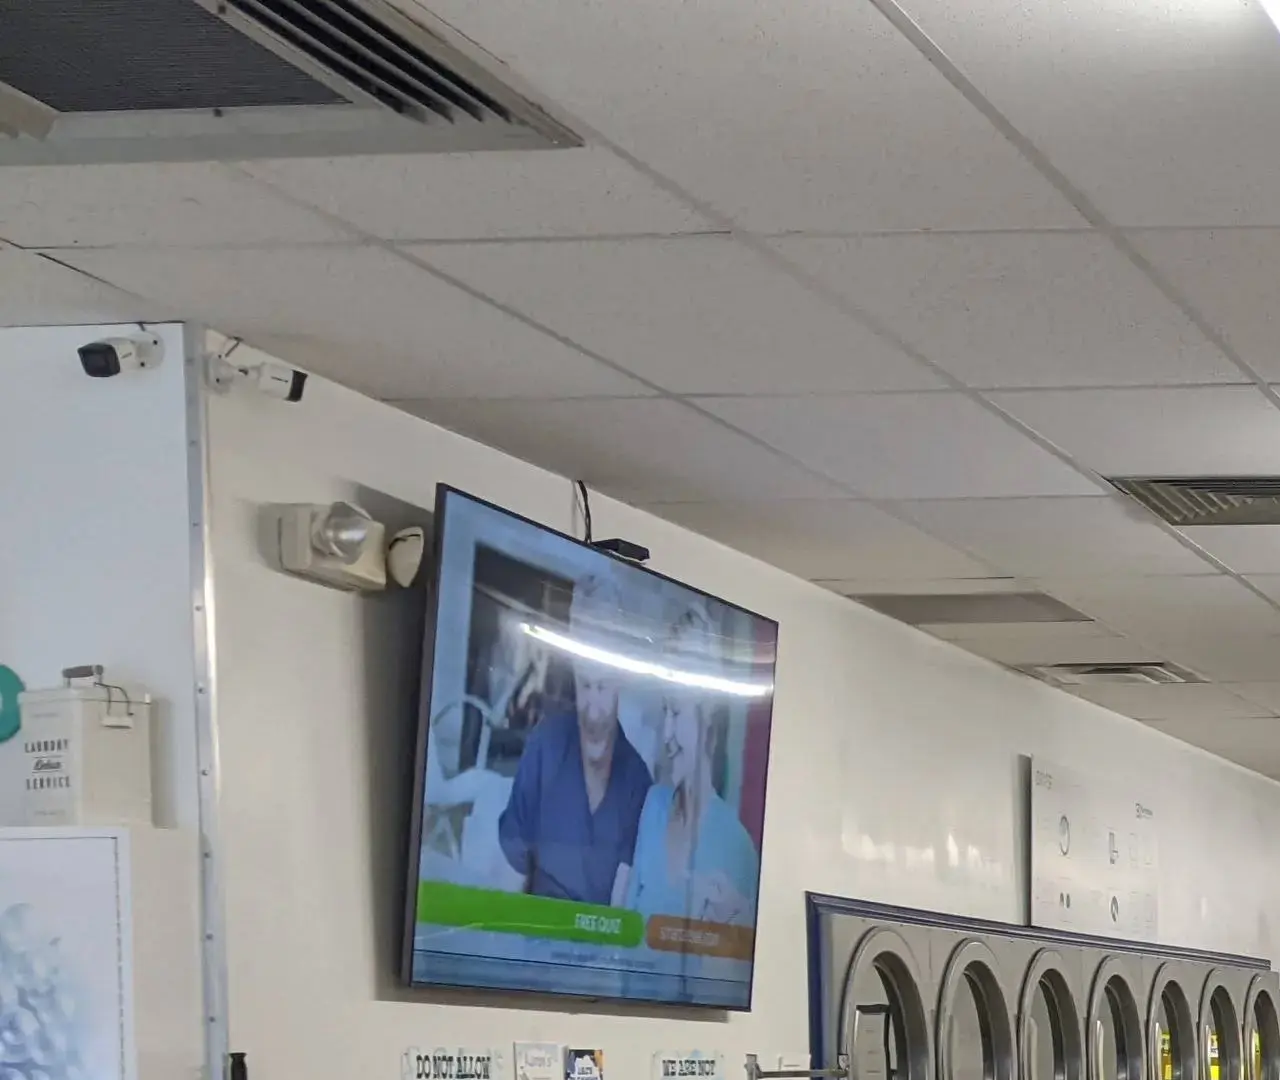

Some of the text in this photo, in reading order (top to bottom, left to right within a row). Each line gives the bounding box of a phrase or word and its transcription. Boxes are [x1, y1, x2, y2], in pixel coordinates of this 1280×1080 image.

[416, 1055, 491, 1079] DO NOT ALLOW
